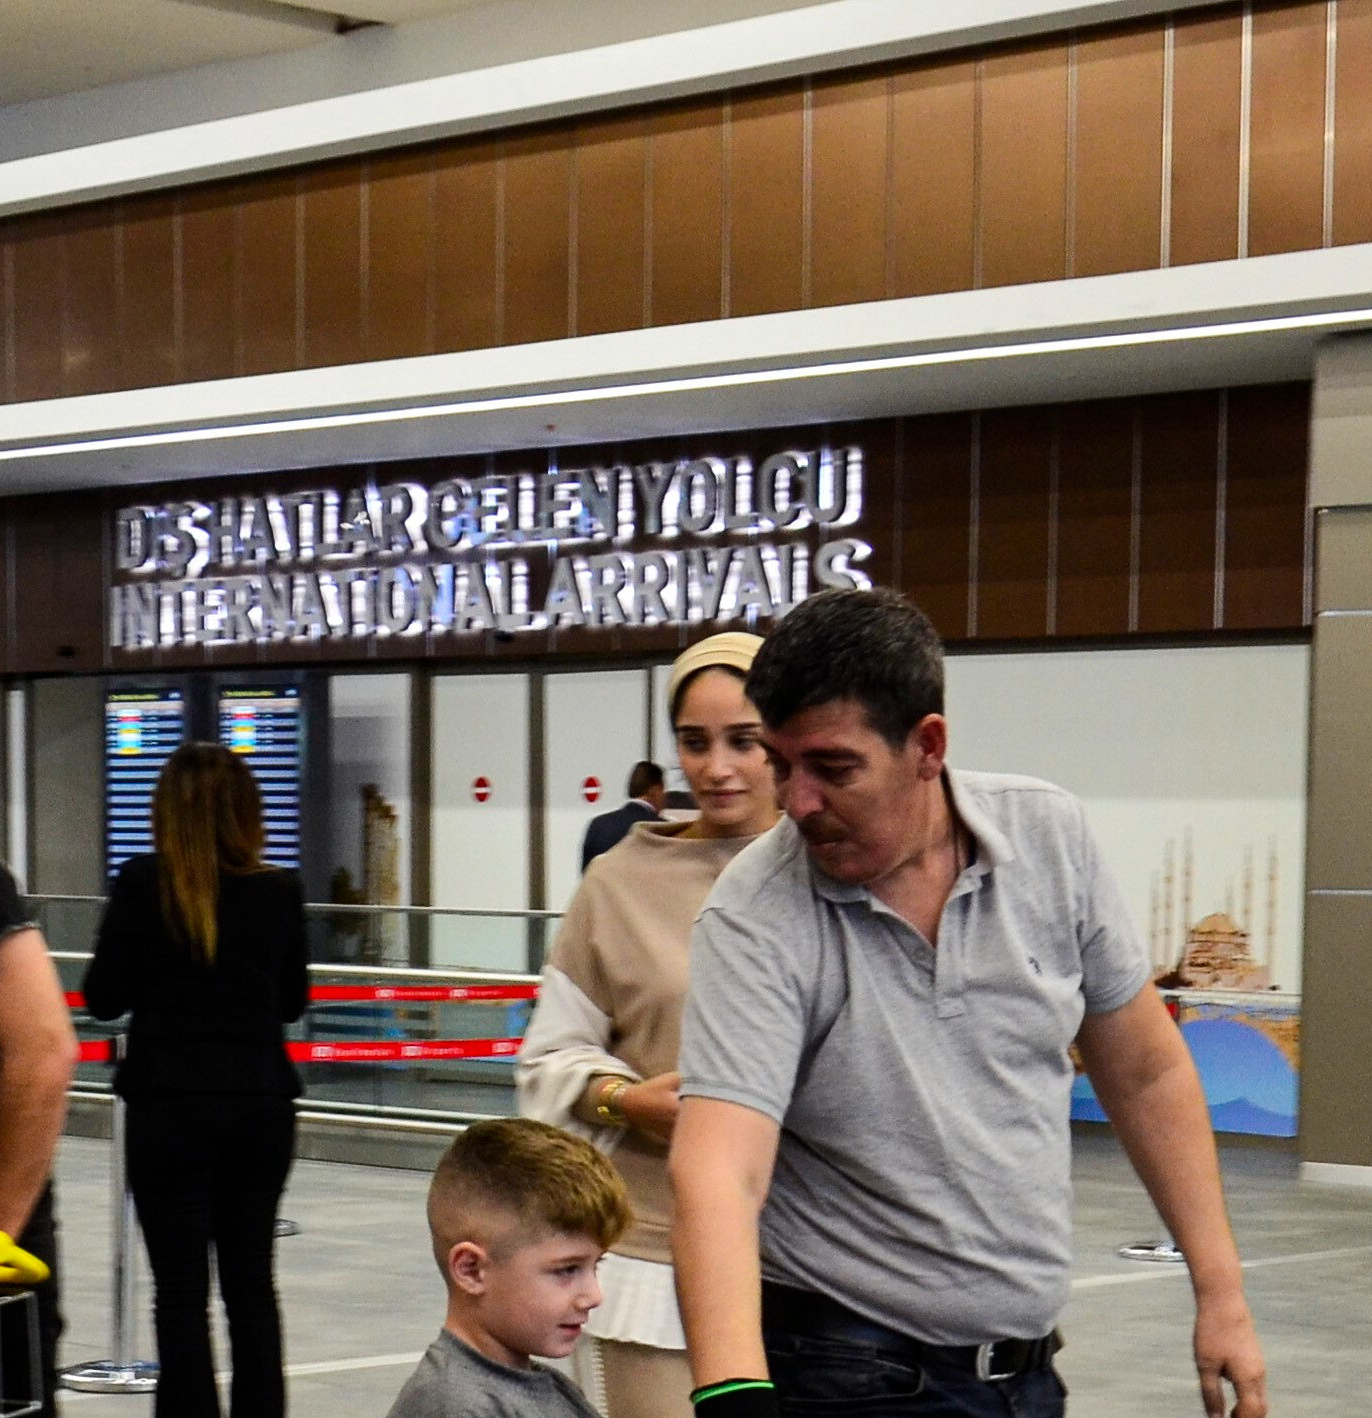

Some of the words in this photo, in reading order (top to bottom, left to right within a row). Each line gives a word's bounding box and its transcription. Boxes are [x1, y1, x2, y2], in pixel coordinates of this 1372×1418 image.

[210, 483, 427, 567] HATLAR
[633, 447, 864, 537] YOLCU
[110, 561, 548, 650] INTERNATIONAL
[541, 538, 873, 628] ARRIVALS
